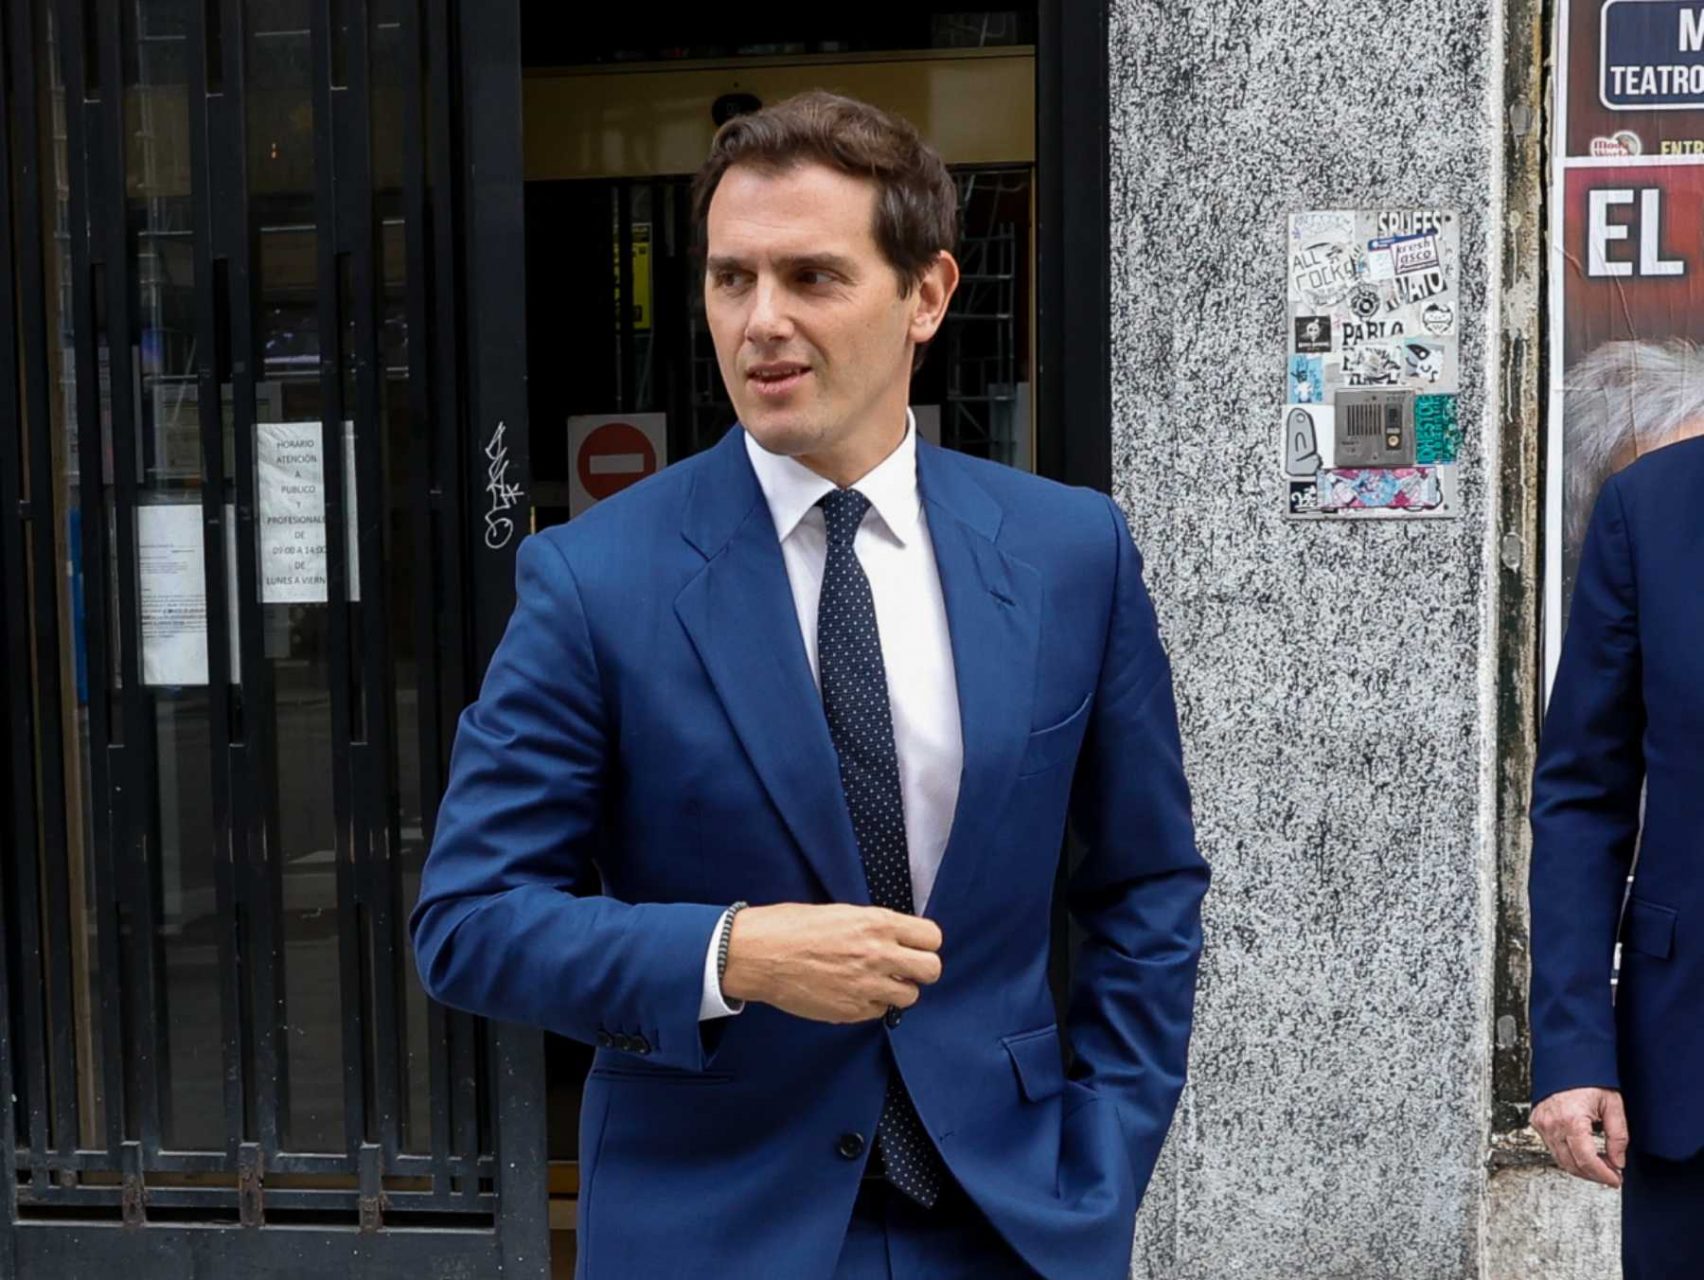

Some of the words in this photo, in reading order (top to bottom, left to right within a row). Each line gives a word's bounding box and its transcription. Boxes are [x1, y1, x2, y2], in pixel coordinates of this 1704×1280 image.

[1610, 65, 1704, 95] TEATRO
[1588, 188, 1685, 277] EL
[277, 440, 315, 449] HORARIO
[295, 470, 301, 478] A
[294, 531, 304, 539] DE
[294, 561, 305, 570] DE
[266, 576, 293, 586] LUNES
[294, 576, 300, 584] A
